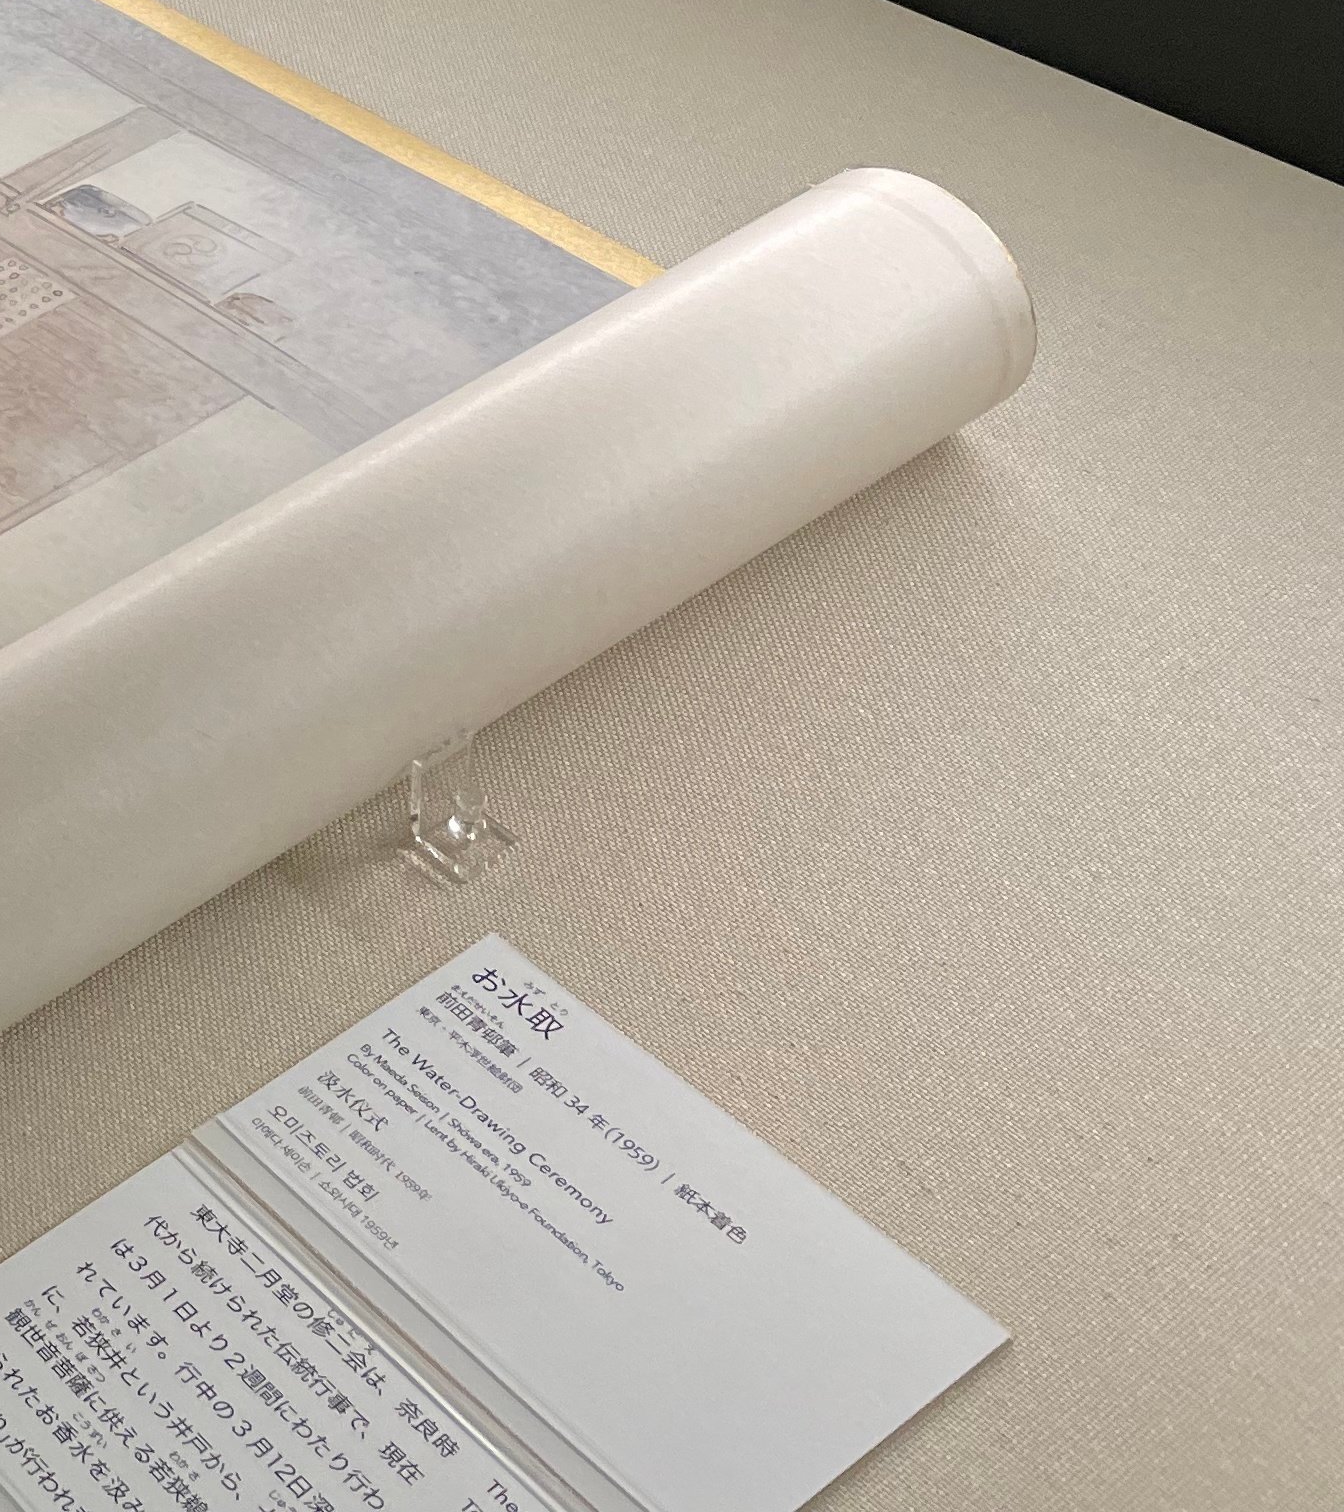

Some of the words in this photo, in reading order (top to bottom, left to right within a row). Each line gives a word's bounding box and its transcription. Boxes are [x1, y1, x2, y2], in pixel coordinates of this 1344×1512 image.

[472, 968, 565, 1040] お水取
[317, 1070, 388, 1132] 汲水仪式
[360, 1044, 375, 1057] By
[373, 1055, 408, 1086] Maeda
[504, 1164, 531, 1186] 1959
[382, 1028, 410, 1056] The
[412, 1054, 526, 1154] Water-Drawing
[529, 1153, 613, 1224] Ceremony
[267, 1106, 347, 1173] 오미즈토리
[343, 1170, 380, 1202] 법회
[347, 1054, 375, 1077] Color
[373, 1078, 387, 1090] on
[384, 1090, 418, 1114] paper
[424, 1119, 450, 1143] Lent
[446, 1138, 461, 1152] by
[592, 1260, 624, 1291] Tokyo
[674, 1184, 746, 1244] 紙本着色
[487, 1478, 519, 1512] The
